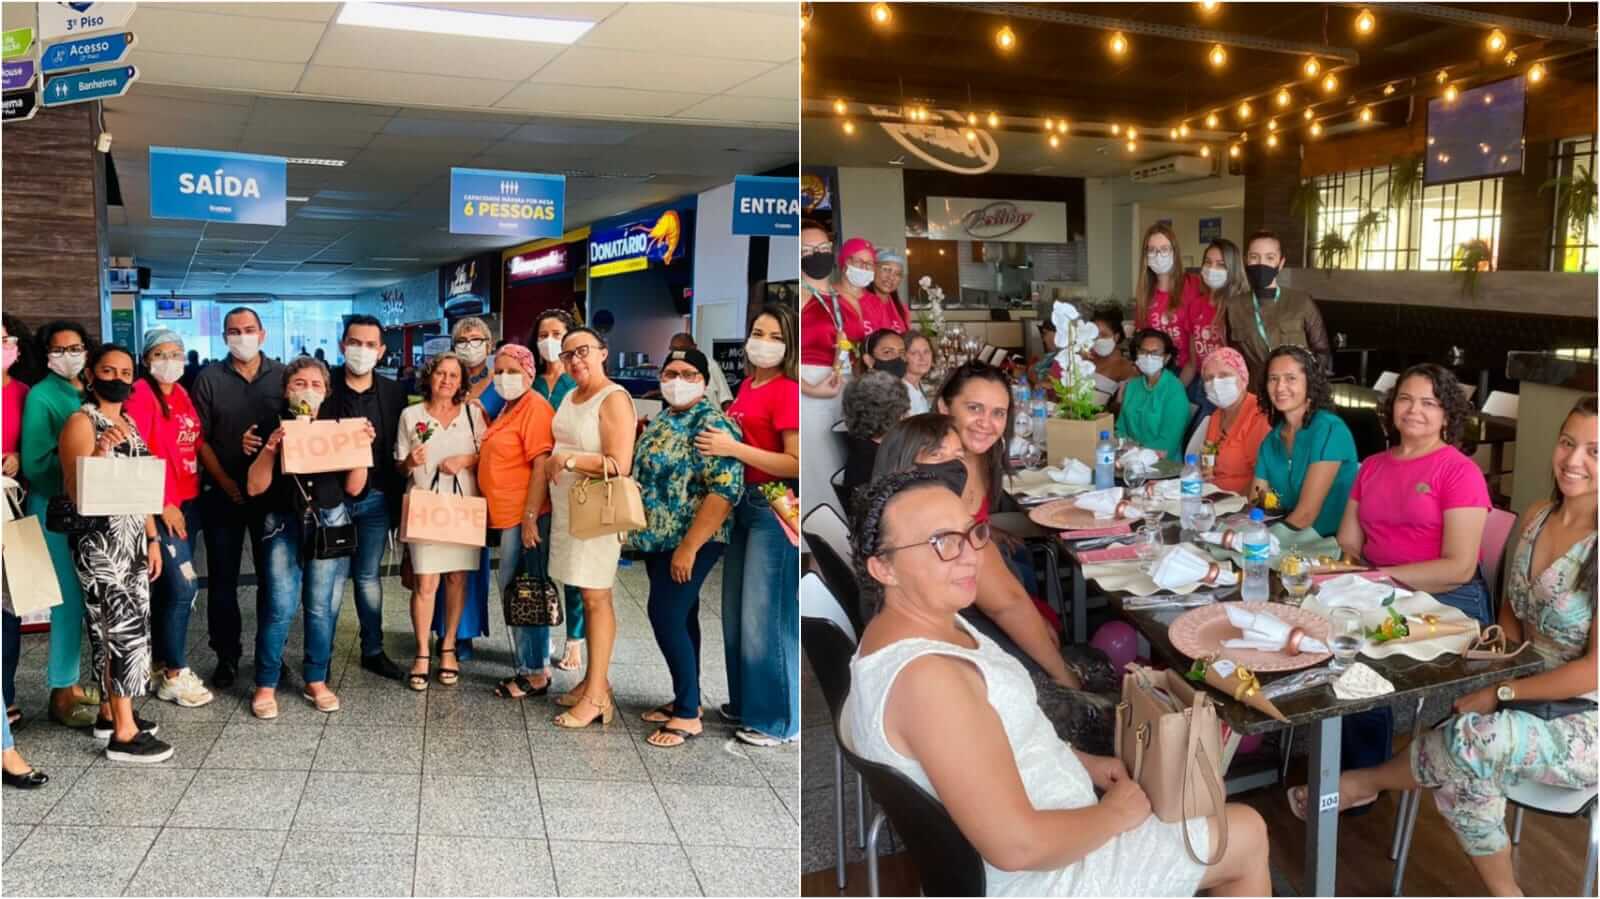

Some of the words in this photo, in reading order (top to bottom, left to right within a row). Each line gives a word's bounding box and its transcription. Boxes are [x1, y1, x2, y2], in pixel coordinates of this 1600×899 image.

[80, 15, 104, 29] Piso
[69, 41, 110, 57] Acesso
[78, 77, 118, 92] Banheiros
[178, 168, 261, 199] SAÍDA
[463, 200, 474, 217] 6
[478, 201, 556, 221] PESSOAS
[740, 197, 799, 215] ENTRA
[590, 228, 648, 262] DONATÁRIO
[286, 430, 370, 460] HOPE
[406, 504, 486, 530] HOPE
